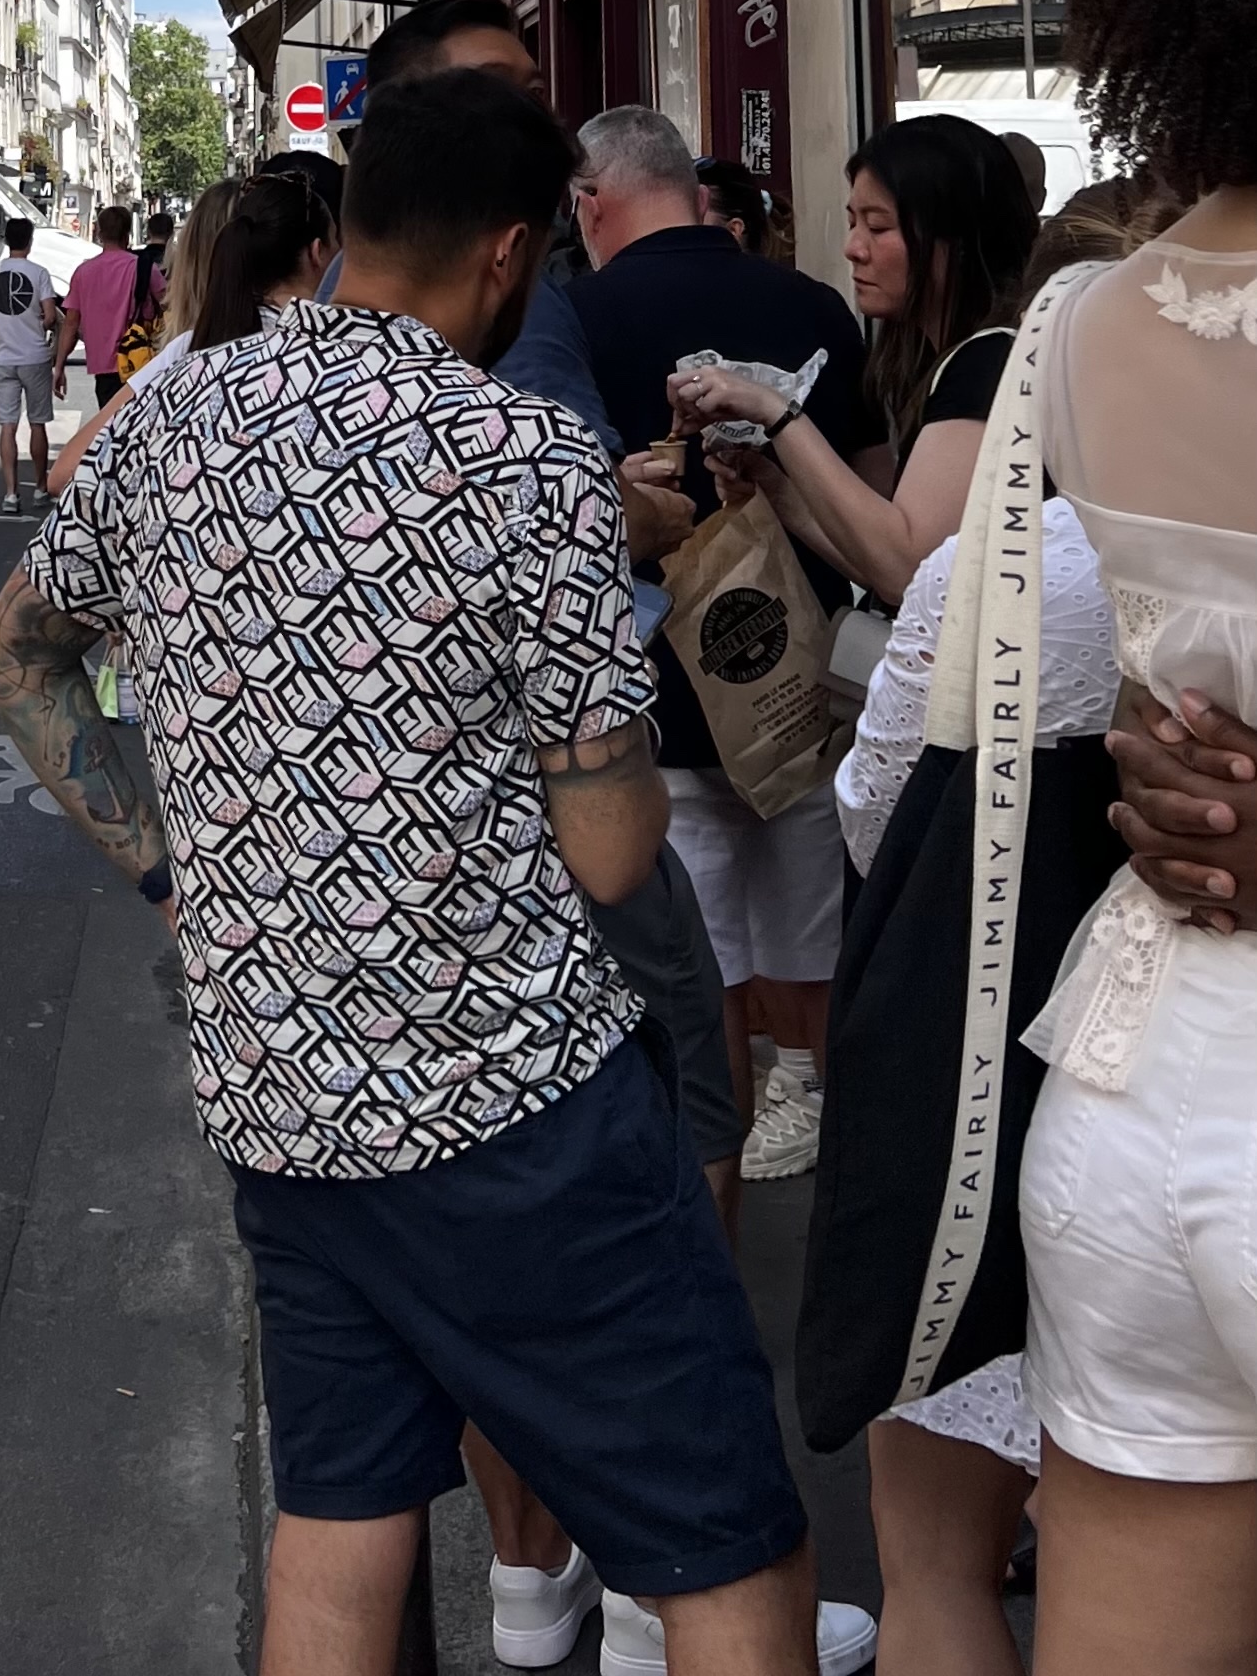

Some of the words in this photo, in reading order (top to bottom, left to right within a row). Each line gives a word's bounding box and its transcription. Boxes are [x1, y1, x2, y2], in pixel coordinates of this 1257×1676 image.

[1000, 425, 1031, 595] JIMMY
[992, 638, 1022, 809] FAIRLY
[980, 840, 1011, 1007] JIMMY
[954, 1054, 992, 1220] FAIRLY
[910, 1248, 964, 1391] JIMMY
